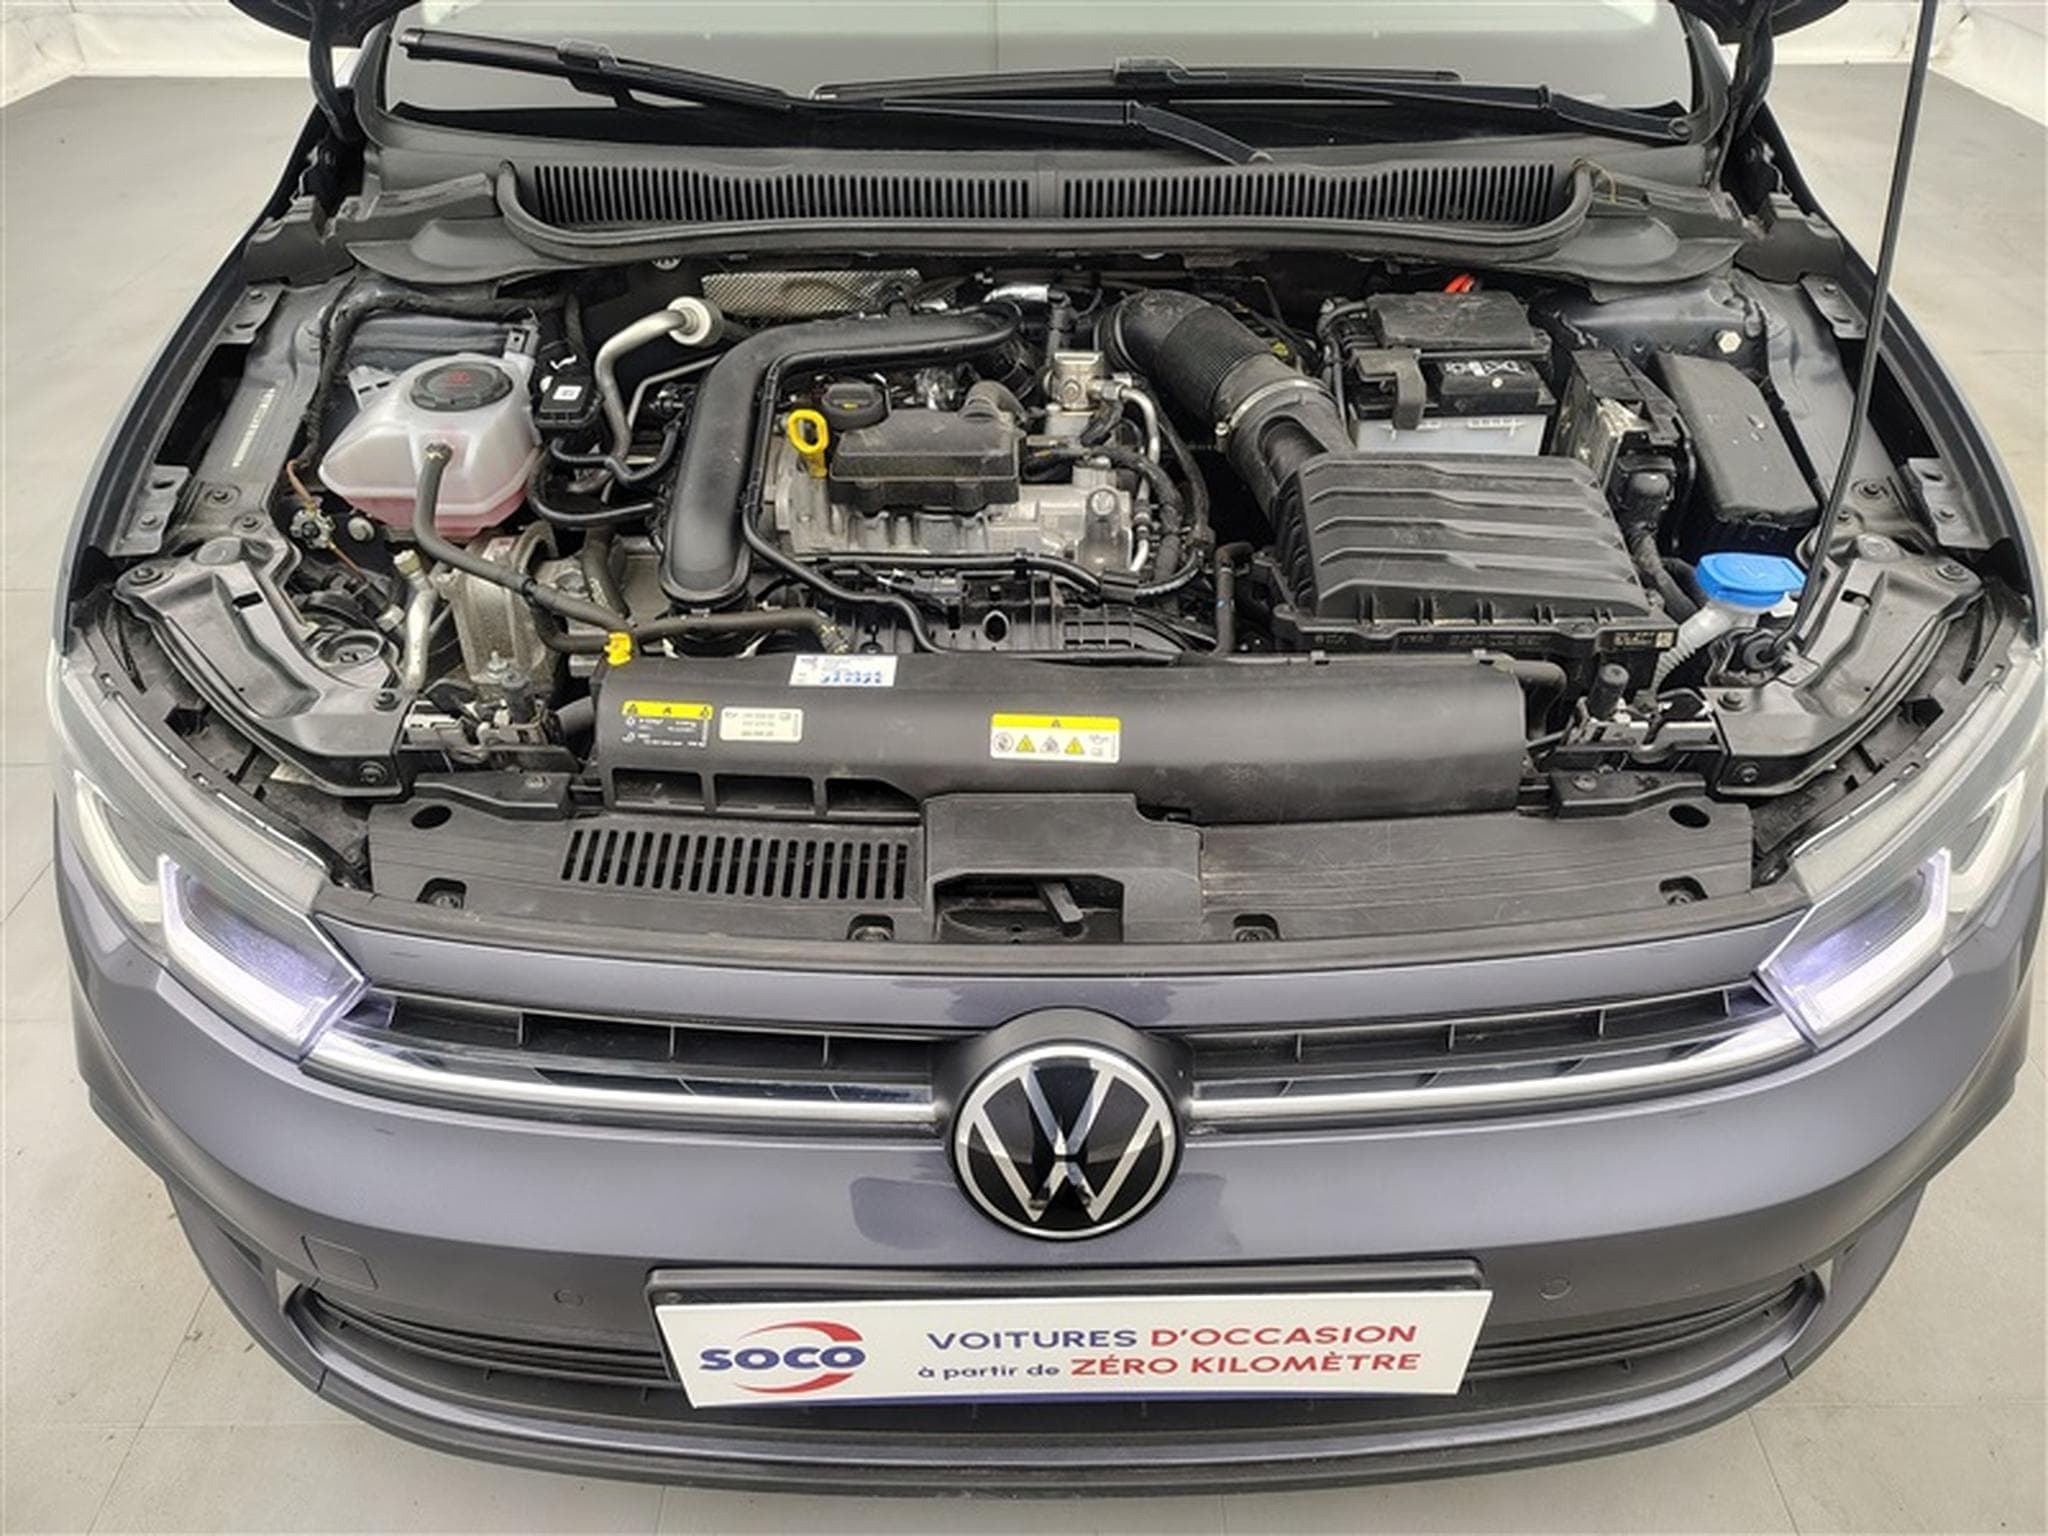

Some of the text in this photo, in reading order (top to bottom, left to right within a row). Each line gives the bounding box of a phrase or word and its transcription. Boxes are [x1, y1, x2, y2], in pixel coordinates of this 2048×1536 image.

[927, 1325, 1417, 1349] VOITURES D'OCCASION
[700, 1346, 866, 1371] SOCO
[918, 1351, 1421, 1381] à partir de ZÉRO KILOMÈTRE
